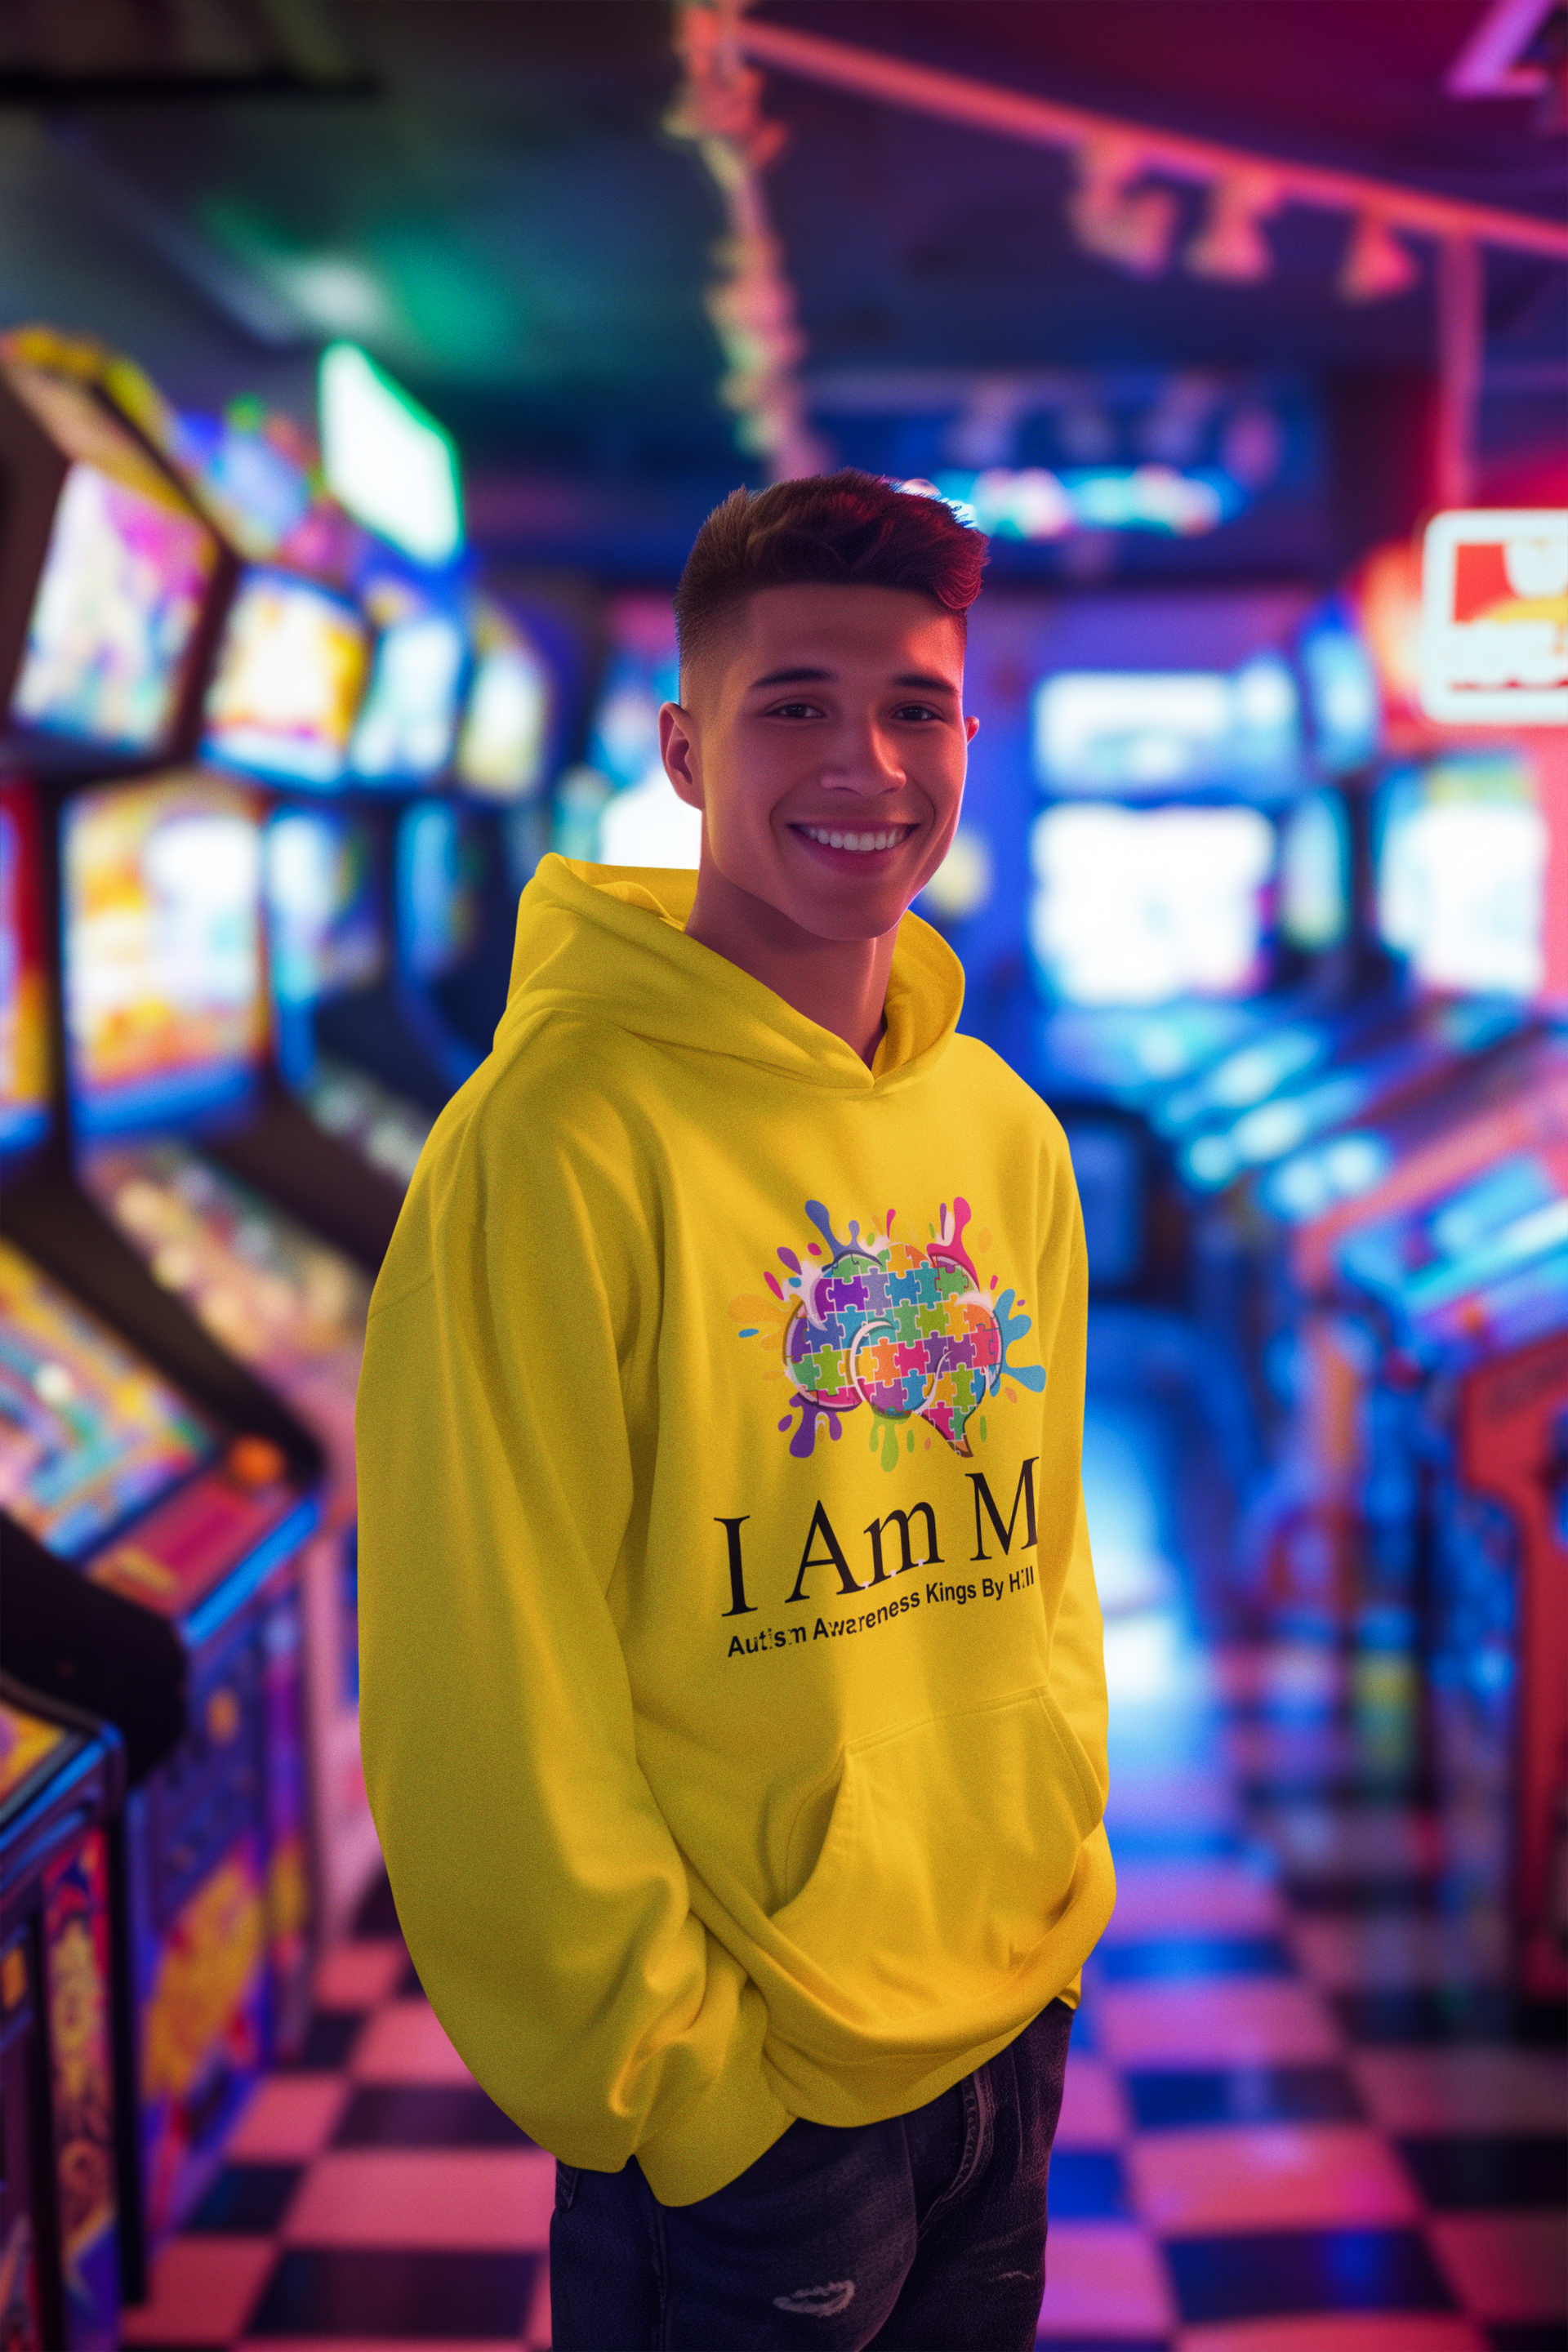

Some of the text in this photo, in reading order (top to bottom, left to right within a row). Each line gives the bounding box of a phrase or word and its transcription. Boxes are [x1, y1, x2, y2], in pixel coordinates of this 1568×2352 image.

[714, 1515, 758, 1617] I
[785, 1499, 945, 1603] Am
[727, 1625, 807, 1657] Autism
[813, 1592, 920, 1640] Awareness
[926, 1581, 977, 1605] Kings
[982, 1578, 1004, 1601] By
